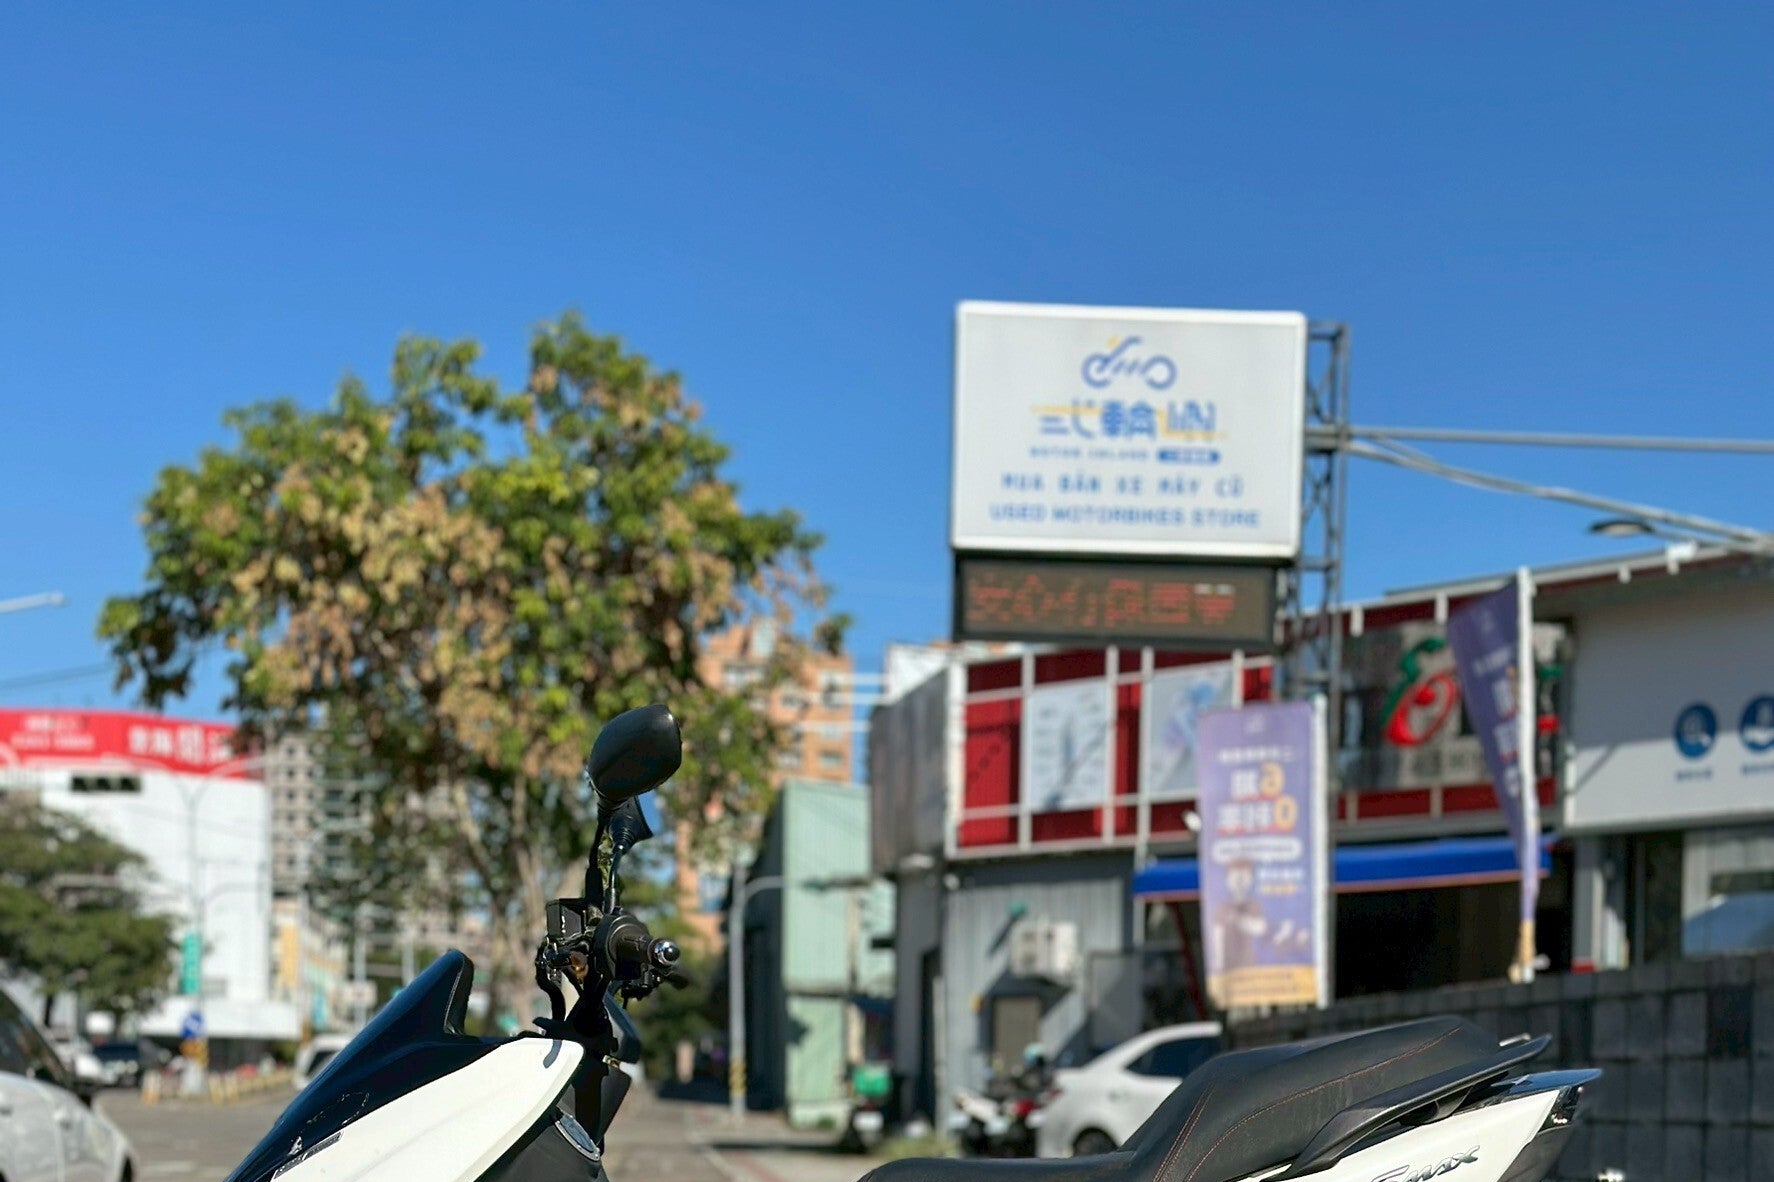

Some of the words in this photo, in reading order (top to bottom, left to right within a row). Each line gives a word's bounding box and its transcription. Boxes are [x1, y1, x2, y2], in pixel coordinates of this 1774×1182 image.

[990, 503, 1047, 523] USED
[1053, 505, 1184, 526] MOTORBIKES
[1191, 507, 1261, 528] STORE
